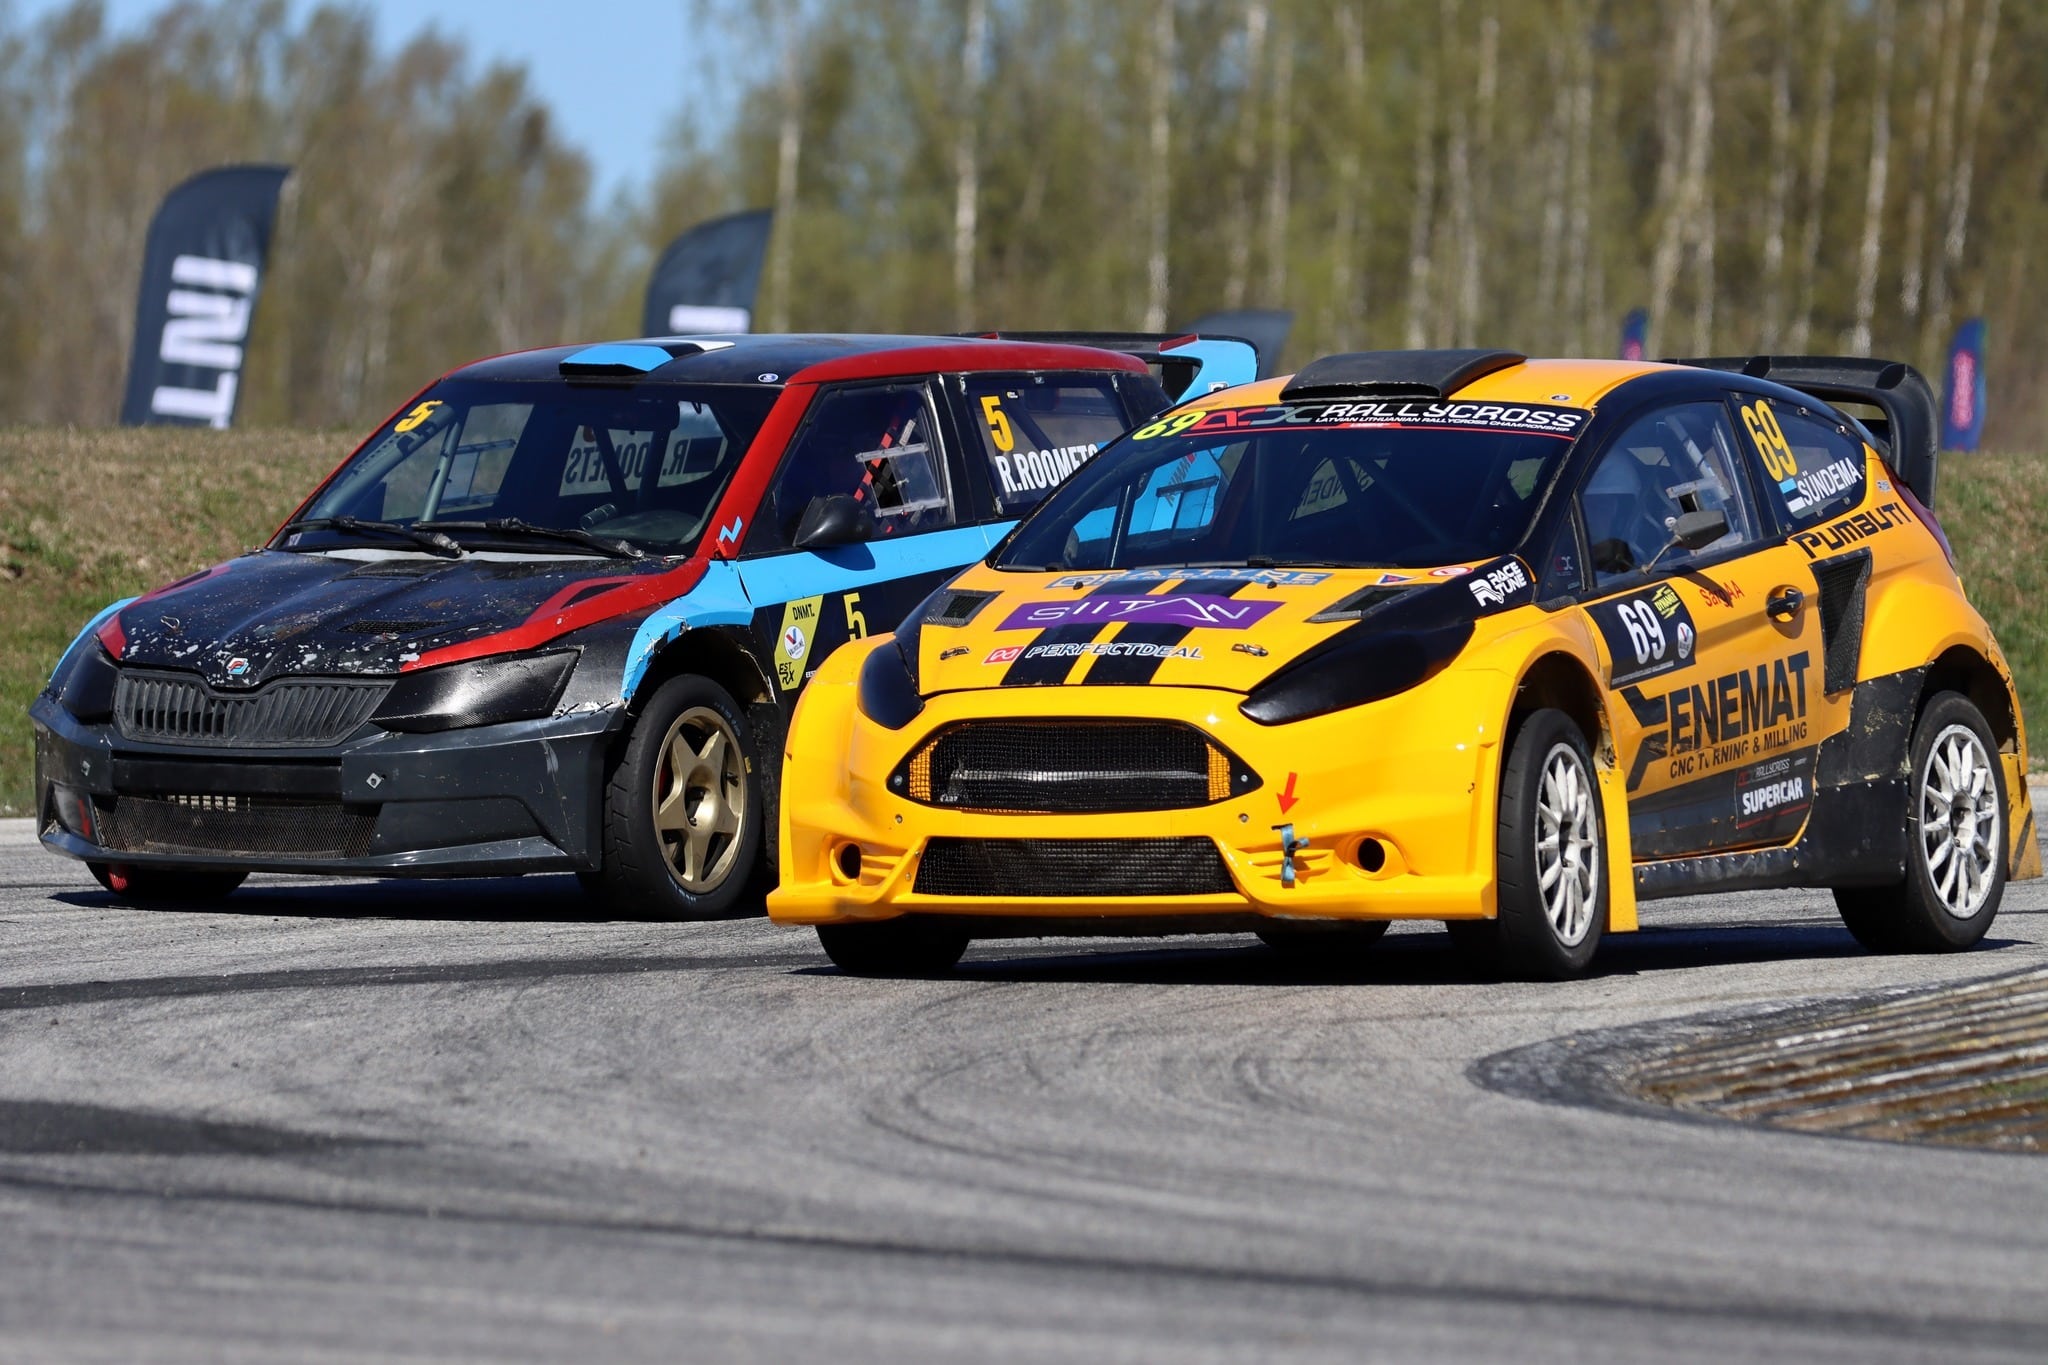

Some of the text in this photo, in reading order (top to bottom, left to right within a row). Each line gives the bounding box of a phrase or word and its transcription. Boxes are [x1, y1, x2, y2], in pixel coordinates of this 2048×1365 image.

[394, 400, 443, 432] 5
[981, 396, 1015, 452] 5
[1132, 411, 1207, 440] 69
[1320, 402, 1583, 428] RALLYCROSS
[1421, 417, 1488, 426] RALLYCROSS
[1489, 419, 1571, 432] CHAMPIONSHIP
[1741, 399, 1798, 482] 69
[1797, 457, 1864, 506] SÜNDEMA
[1487, 561, 1521, 585] RACE
[1494, 573, 1528, 599] TUNE
[843, 592, 868, 641] 5
[1617, 599, 1666, 665] 69
[1025, 643, 1204, 660] PERFECTDEAL
[1669, 651, 1810, 755] ENEMAT
[1670, 754, 1694, 778] CNC
[1753, 736, 1760, 755] &
[1764, 721, 1807, 751] MILLING
[1742, 776, 1804, 815] SUPERCAR
